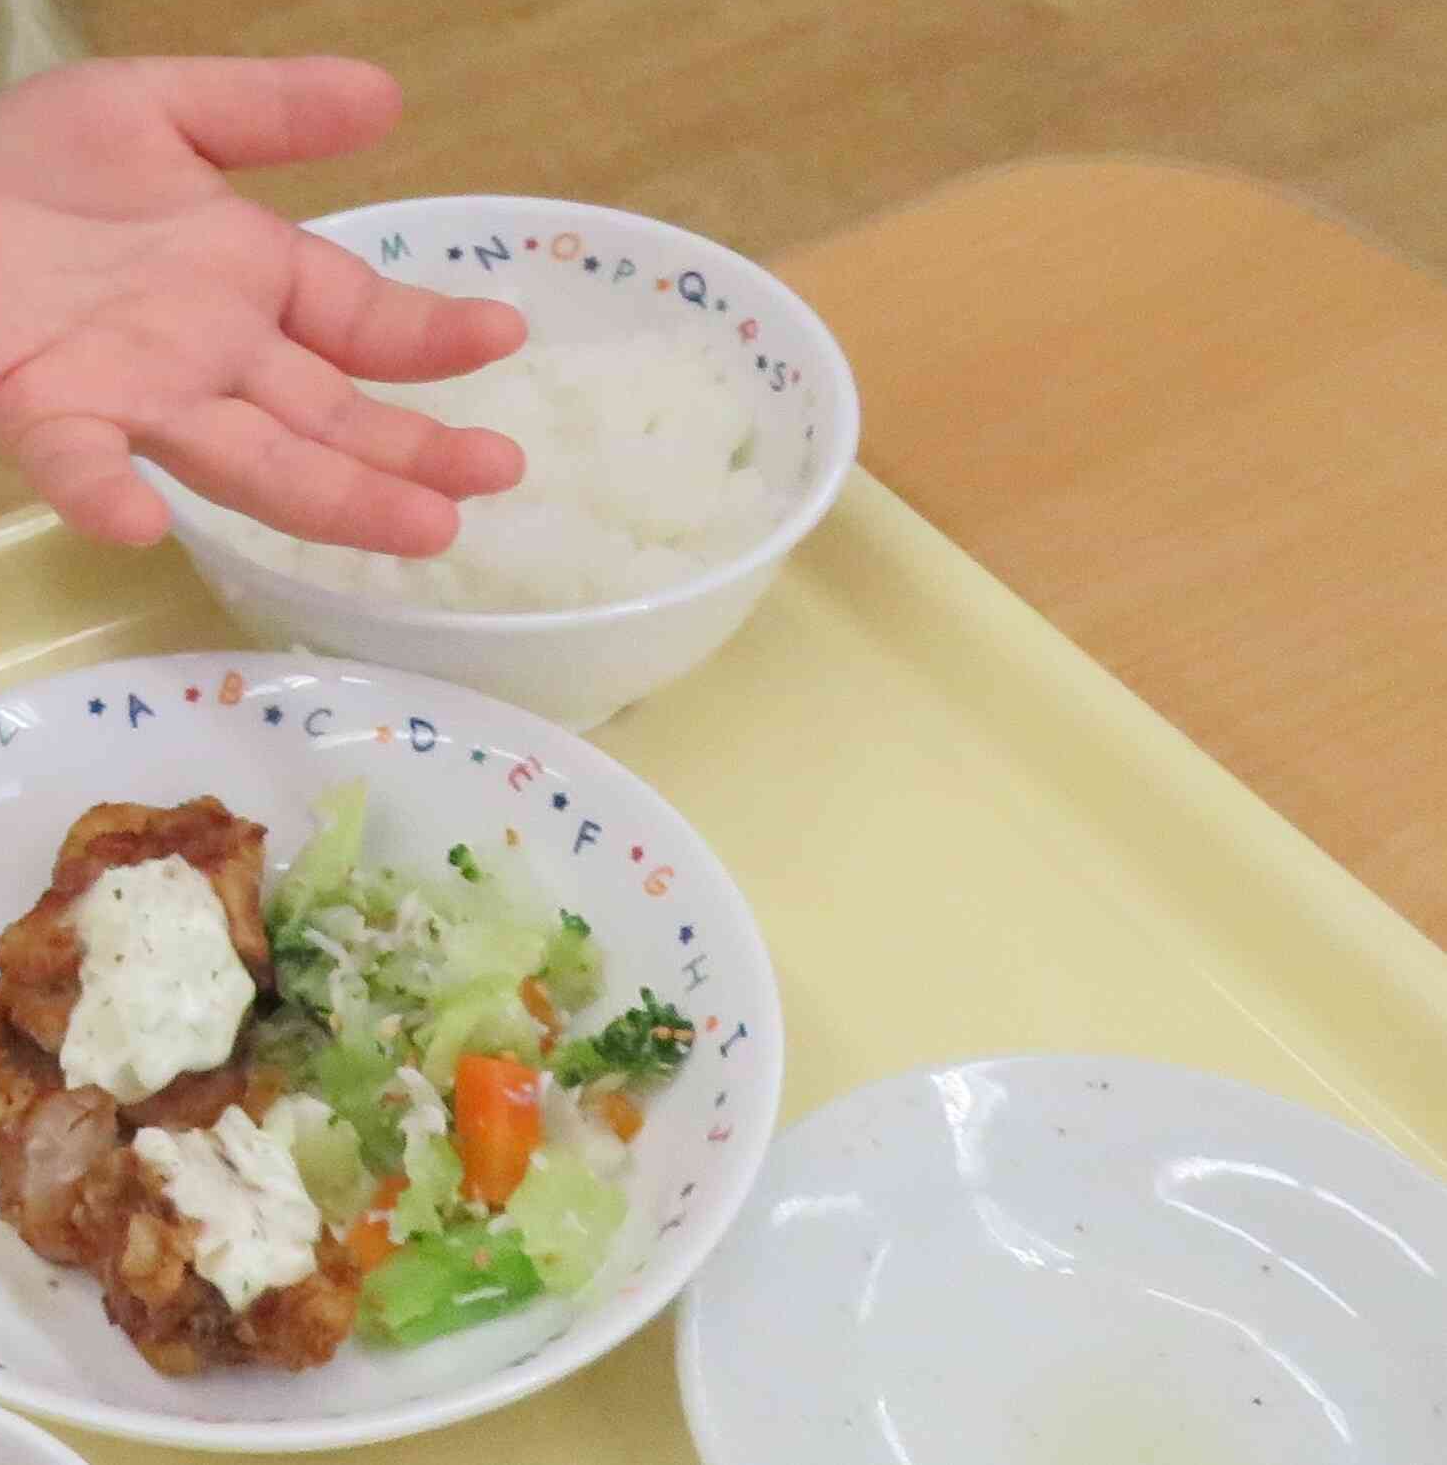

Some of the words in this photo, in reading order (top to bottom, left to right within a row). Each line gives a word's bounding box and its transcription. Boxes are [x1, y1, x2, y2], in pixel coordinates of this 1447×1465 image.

[381, 233, 412, 264] M
[473, 235, 511, 271] N
[551, 232, 581, 262] O
[613, 258, 636, 283] P
[678, 271, 707, 308] Q
[770, 361, 786, 392] S
[128, 693, 156, 729] A
[217, 671, 245, 706] B
[305, 707, 333, 737] C
[409, 716, 437, 753] D
[508, 755, 544, 792] E
[573, 819, 603, 855] F
[642, 864, 676, 898] G
[682, 953, 708, 993] H
